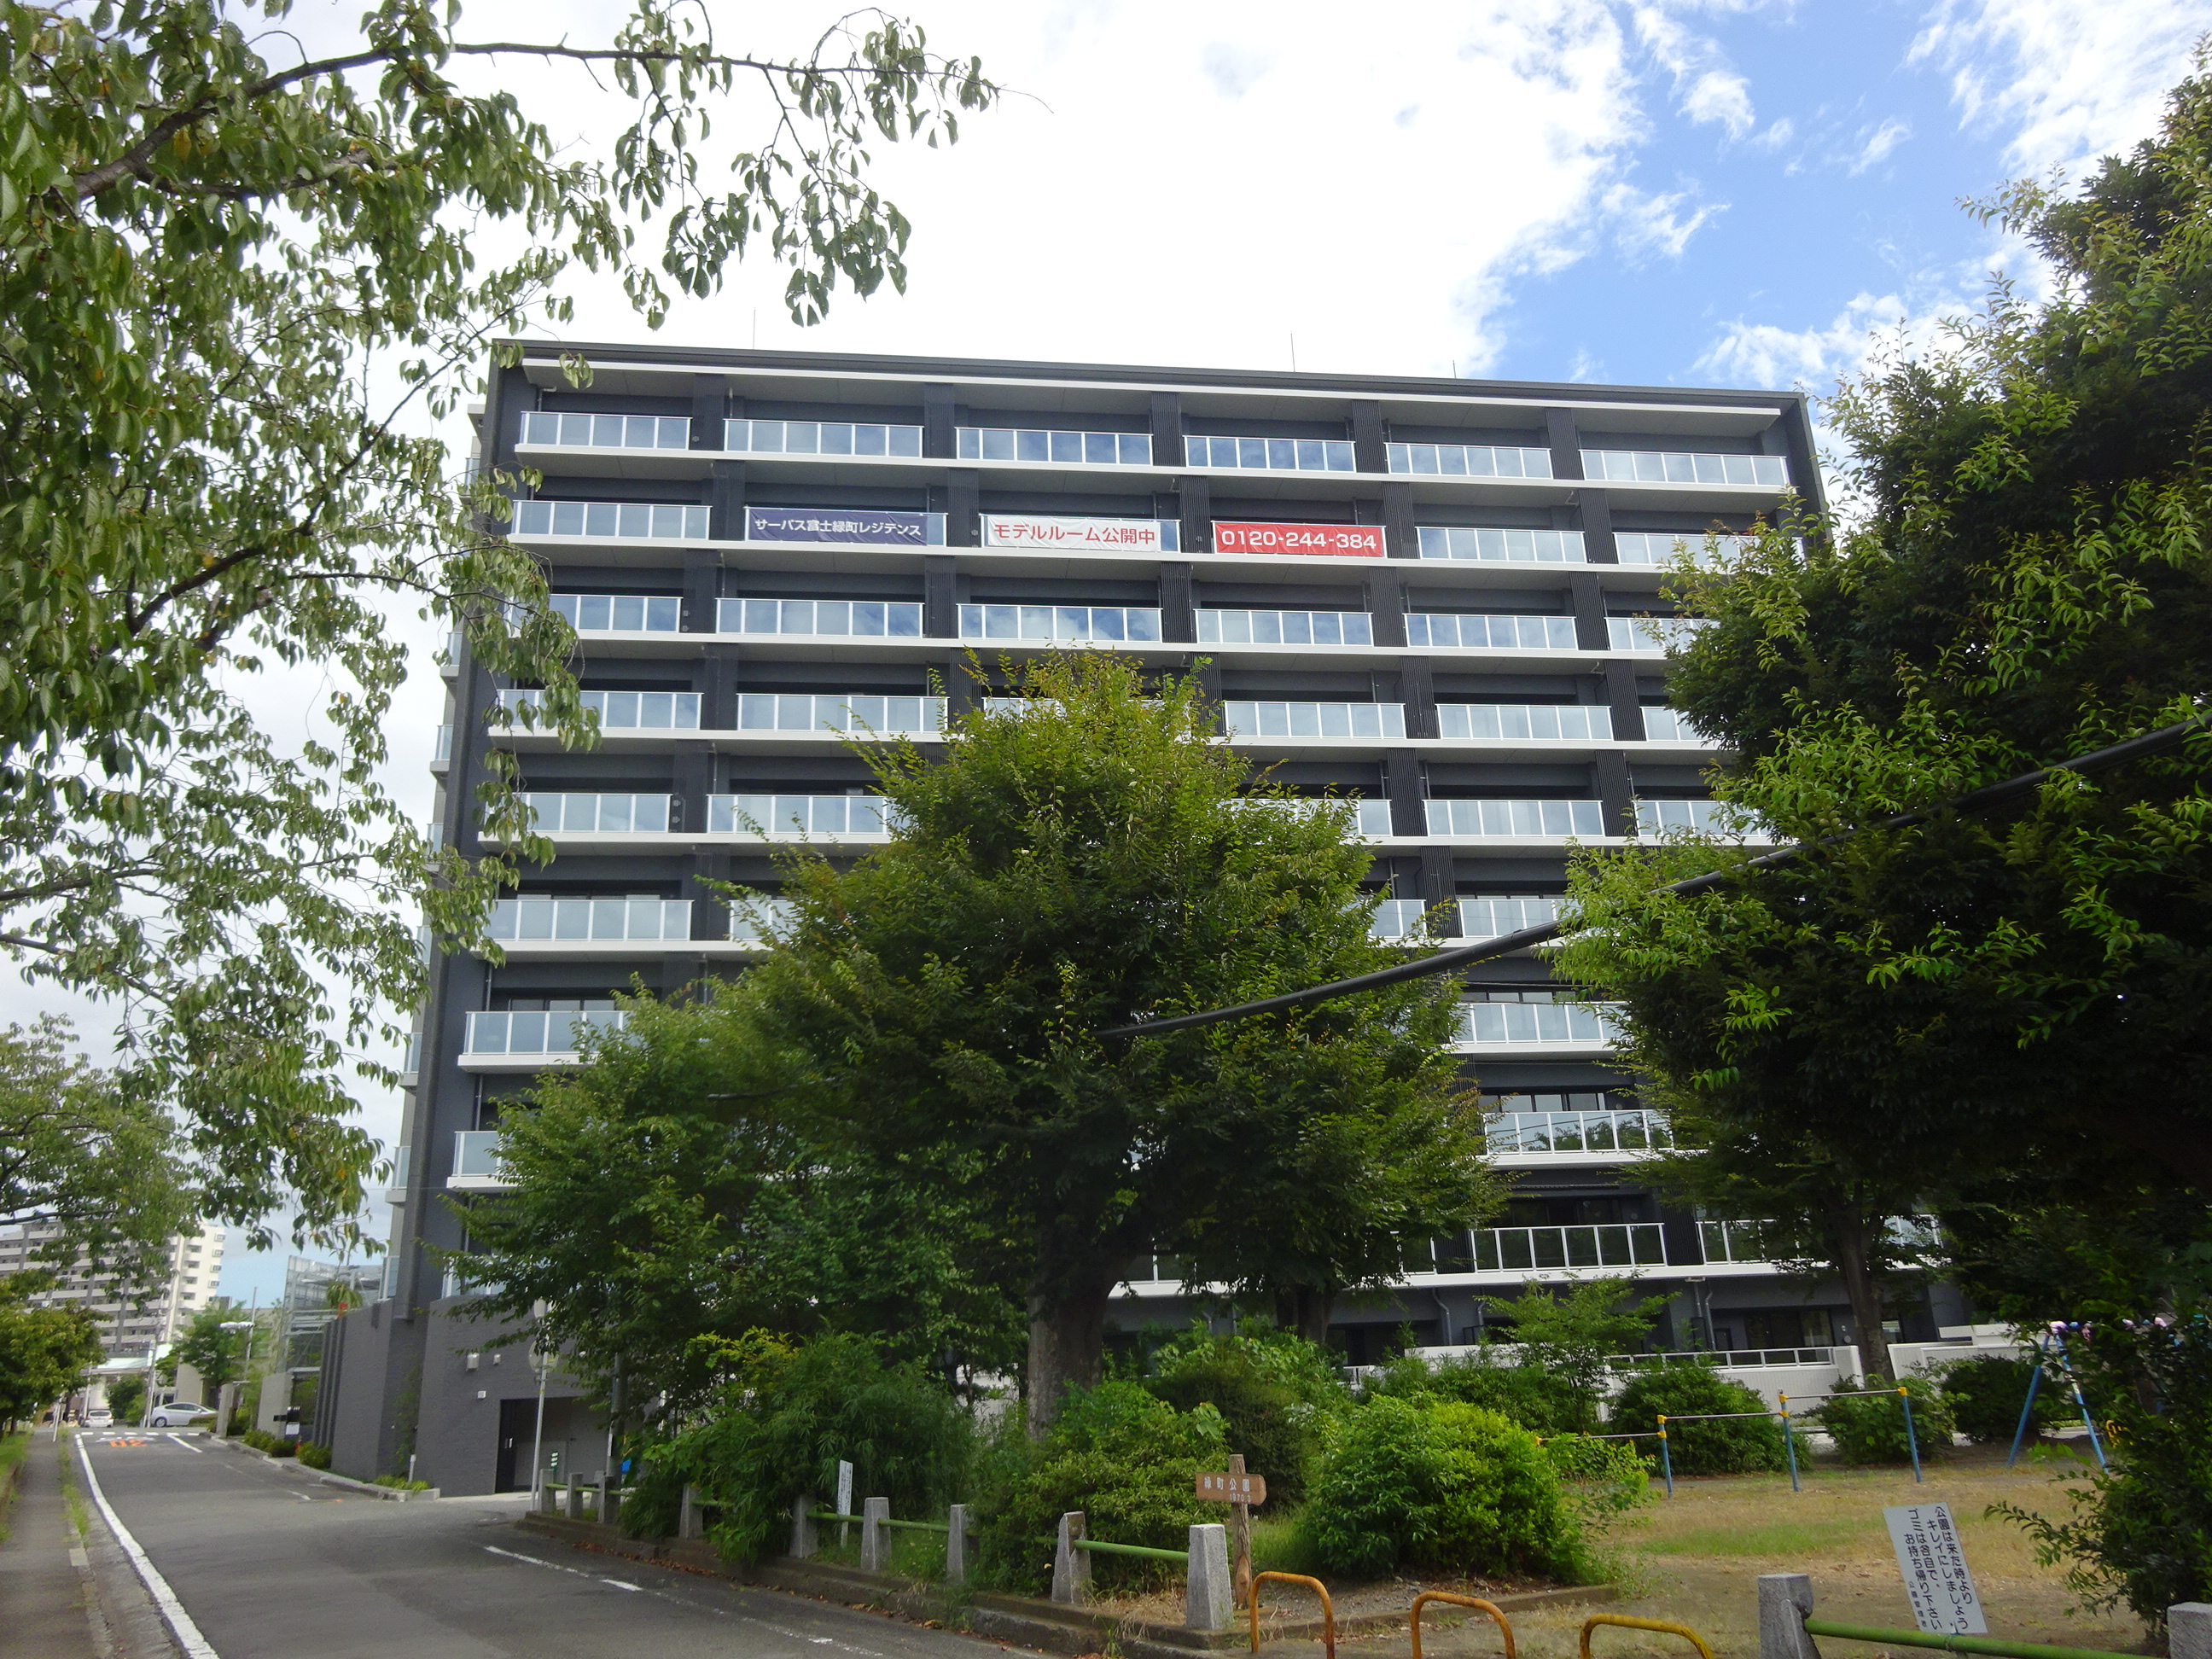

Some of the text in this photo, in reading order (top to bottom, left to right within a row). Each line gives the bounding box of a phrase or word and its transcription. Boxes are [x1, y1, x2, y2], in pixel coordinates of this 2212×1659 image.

[994, 524, 1155, 544] モデルルーム公開中
[1221, 530, 1377, 550] 0120-244-384
[1904, 1534, 1942, 1630] お持ち帰り下さい
[1926, 1519, 1968, 1630] キレイにしましょう
